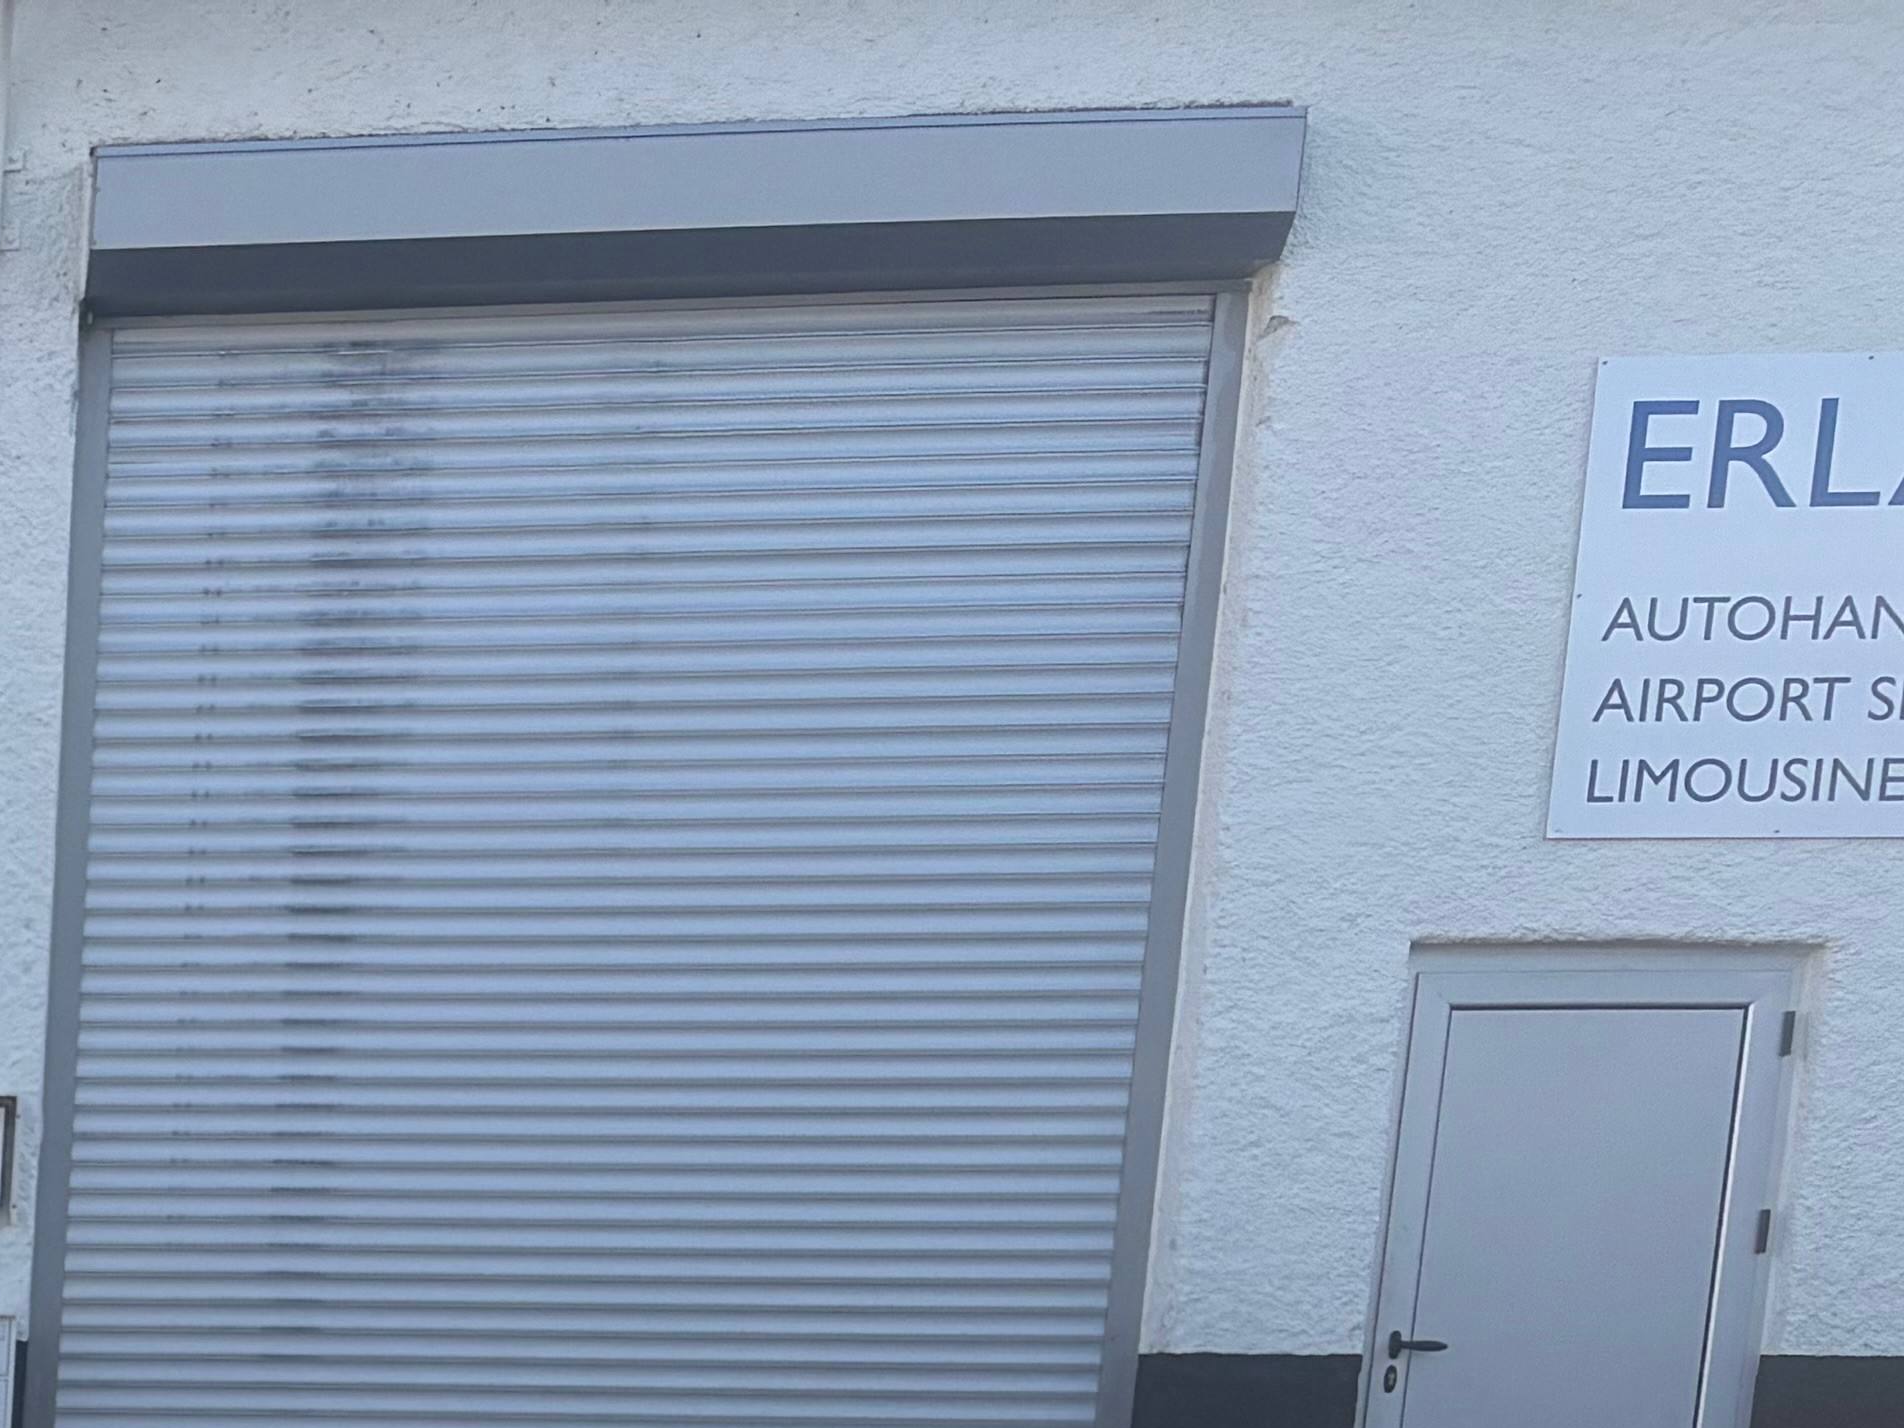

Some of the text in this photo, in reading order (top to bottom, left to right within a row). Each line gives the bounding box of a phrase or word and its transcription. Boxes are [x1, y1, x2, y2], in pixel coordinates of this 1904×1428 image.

[1622, 396, 1904, 509] ERL
[1592, 675, 1904, 723] AIRPORT S
[1586, 757, 1904, 803] LIMOUSINE
